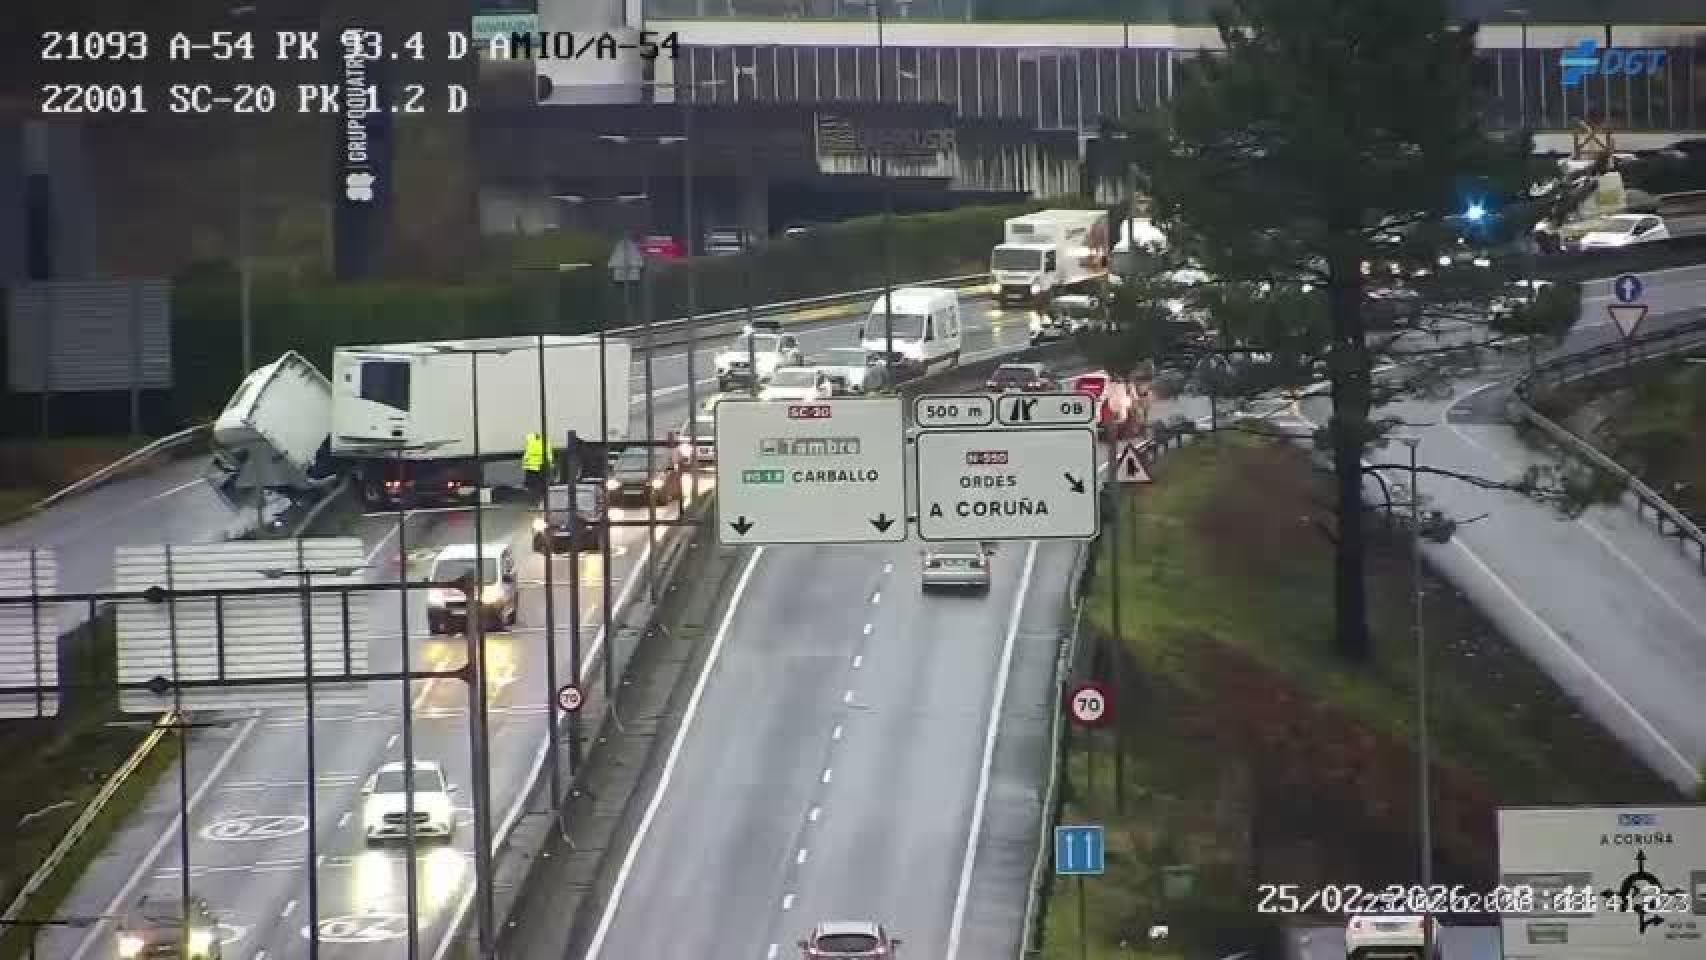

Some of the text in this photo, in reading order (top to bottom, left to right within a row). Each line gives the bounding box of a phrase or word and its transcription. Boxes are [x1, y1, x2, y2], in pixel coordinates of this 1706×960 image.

[927, 405, 983, 418] 500 m
[792, 470, 879, 483] CARBALLO
[960, 475, 1017, 488] ORDES
[929, 497, 1049, 517] A CORUÑA
[1077, 697, 1101, 712] 70
